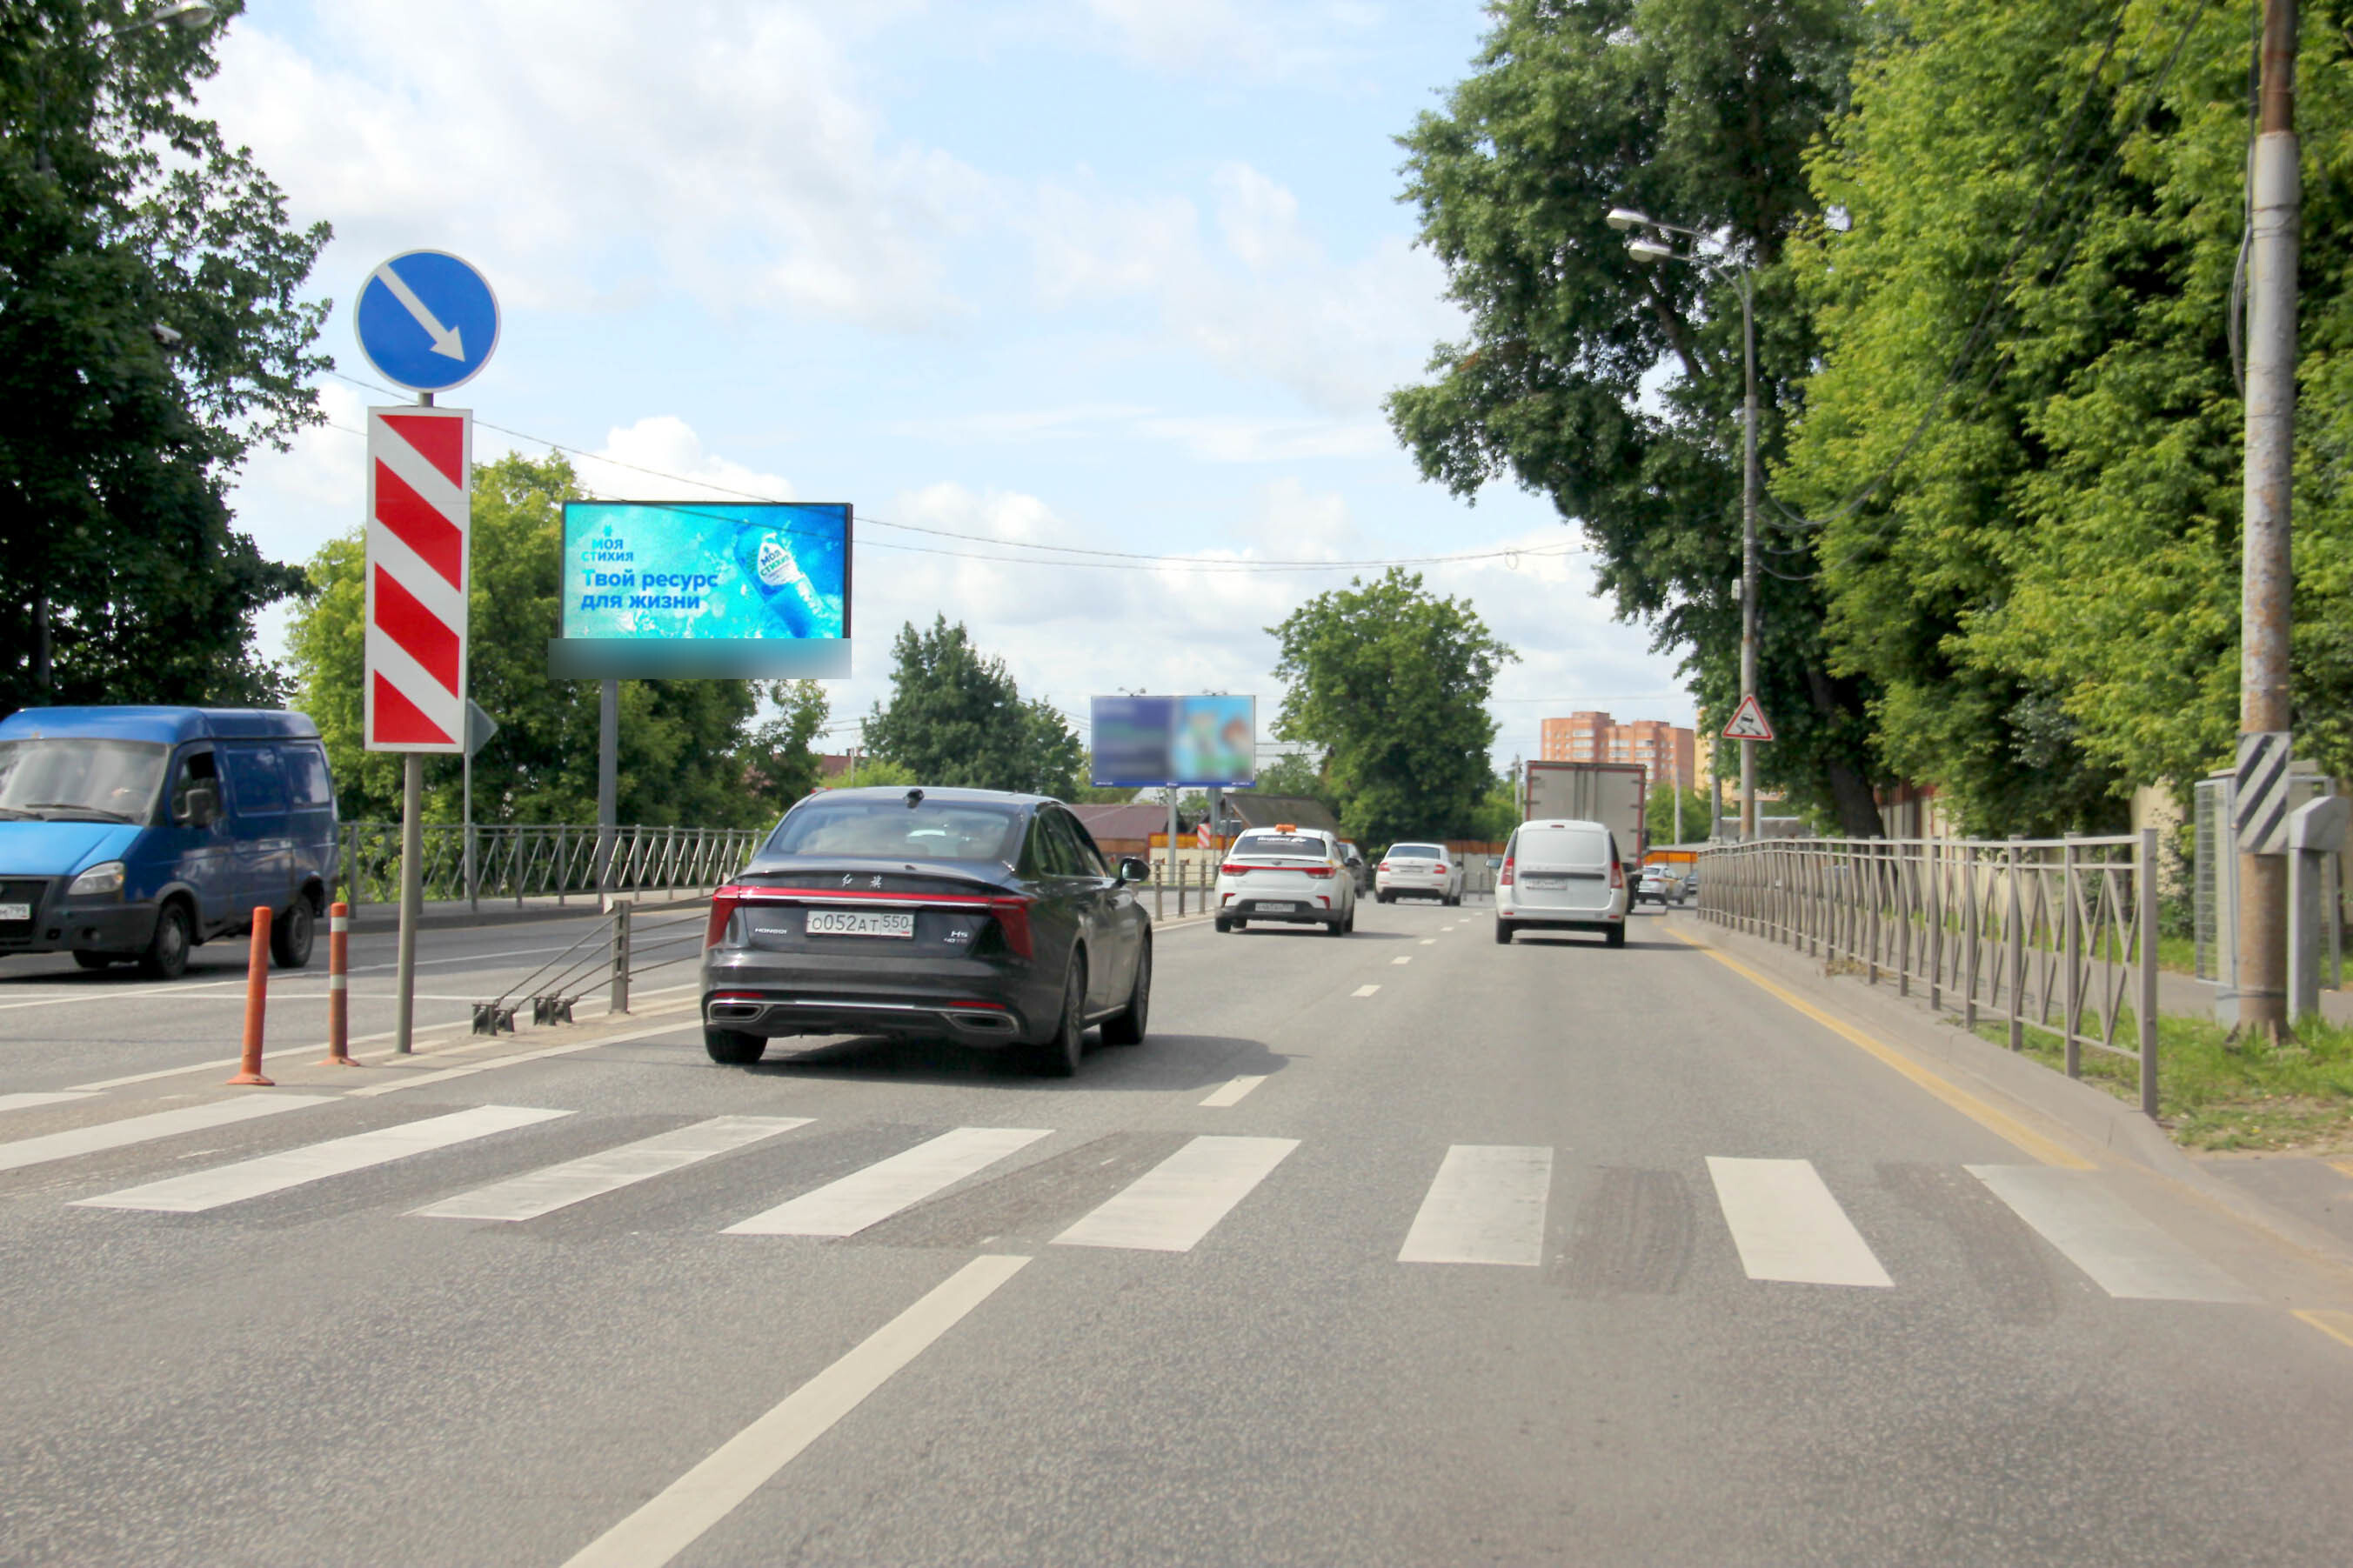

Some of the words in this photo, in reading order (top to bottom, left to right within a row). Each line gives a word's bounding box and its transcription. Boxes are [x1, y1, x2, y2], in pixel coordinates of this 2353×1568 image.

[582, 569, 636, 587] Твой
[642, 574, 719, 591] ресурс
[581, 595, 623, 611] для
[629, 595, 700, 609] жизни
